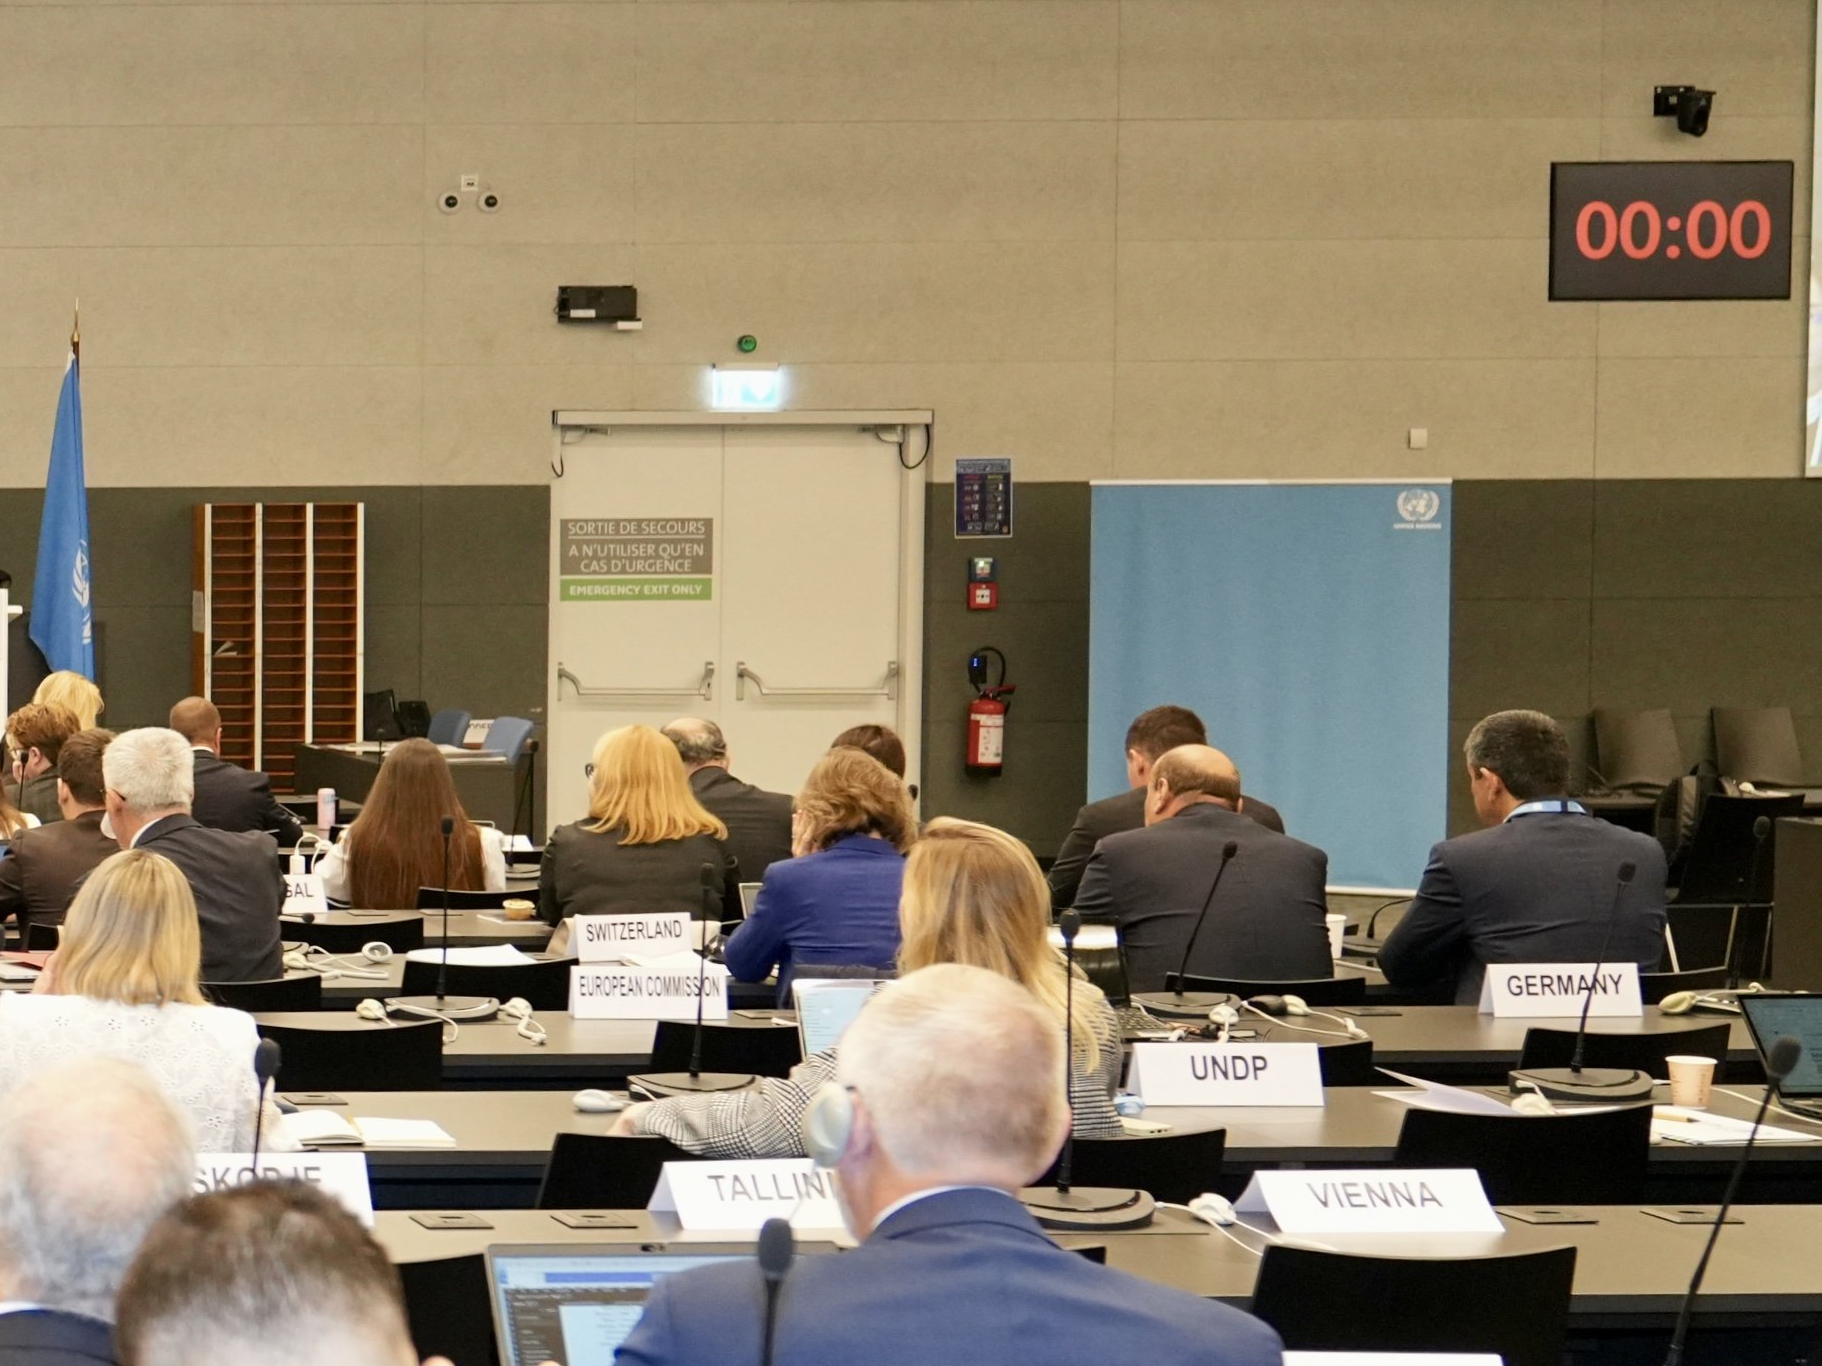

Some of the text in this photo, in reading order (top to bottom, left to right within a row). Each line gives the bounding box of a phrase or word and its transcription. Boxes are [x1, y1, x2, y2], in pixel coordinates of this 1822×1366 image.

[1575, 201, 1771, 260] 00:00
[568, 521, 705, 535] SORTIE DE SECOURS
[569, 543, 705, 558] A N'UTILISER QU'EN
[580, 559, 692, 572] CAS D'URGENCE
[569, 585, 703, 596] EMERGENCY EXIT ONLY
[587, 920, 682, 942] SWITZERLAND
[580, 975, 720, 997] EUROPEAN COMMISSON
[1507, 973, 1624, 999] GERMANY
[1190, 1055, 1269, 1082] UNDP
[1306, 1181, 1443, 1210] VIENNA
